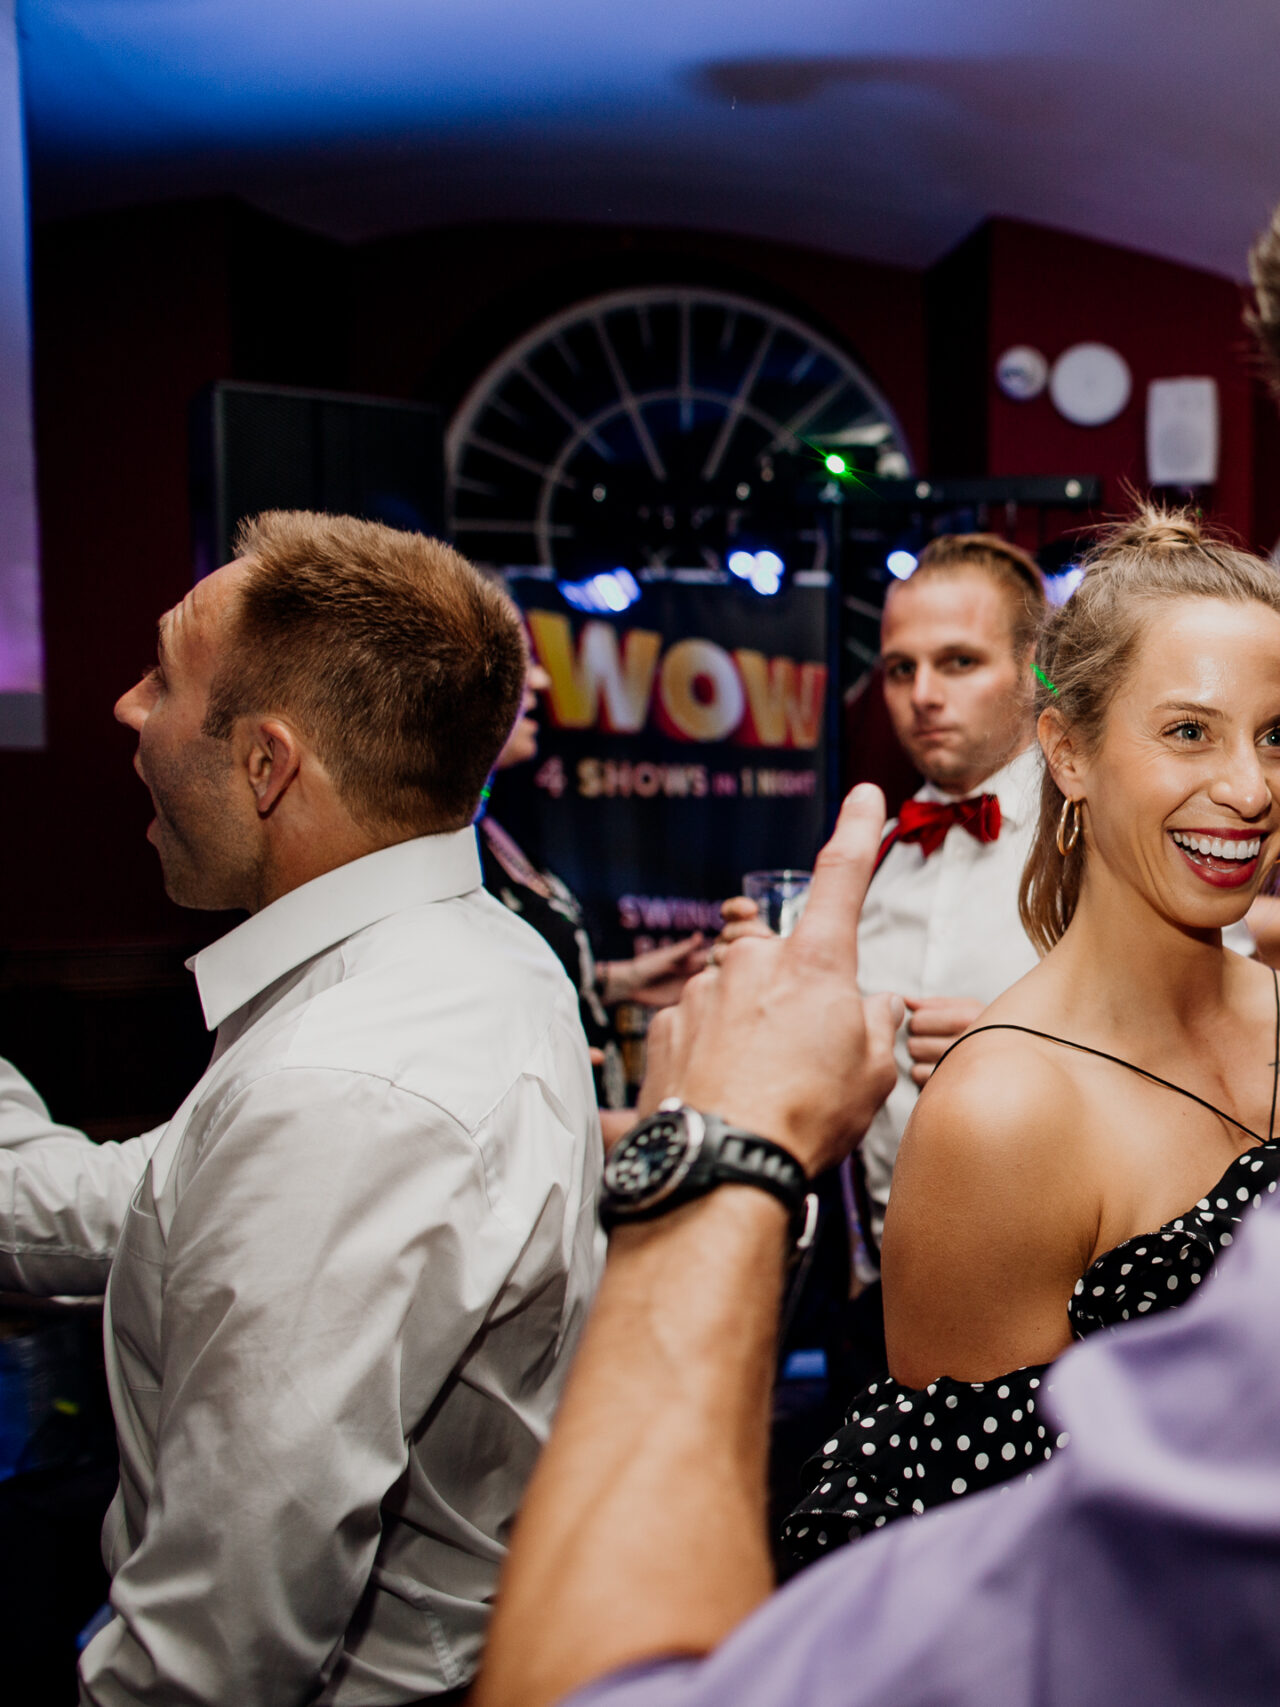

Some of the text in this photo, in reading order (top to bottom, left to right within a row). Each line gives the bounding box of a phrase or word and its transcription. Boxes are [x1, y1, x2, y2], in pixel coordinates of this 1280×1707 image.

[527, 611, 827, 749] WOW
[535, 757, 566, 797] 4
[578, 759, 707, 798] SHOWS
[756, 770, 817, 797] NIGHT
